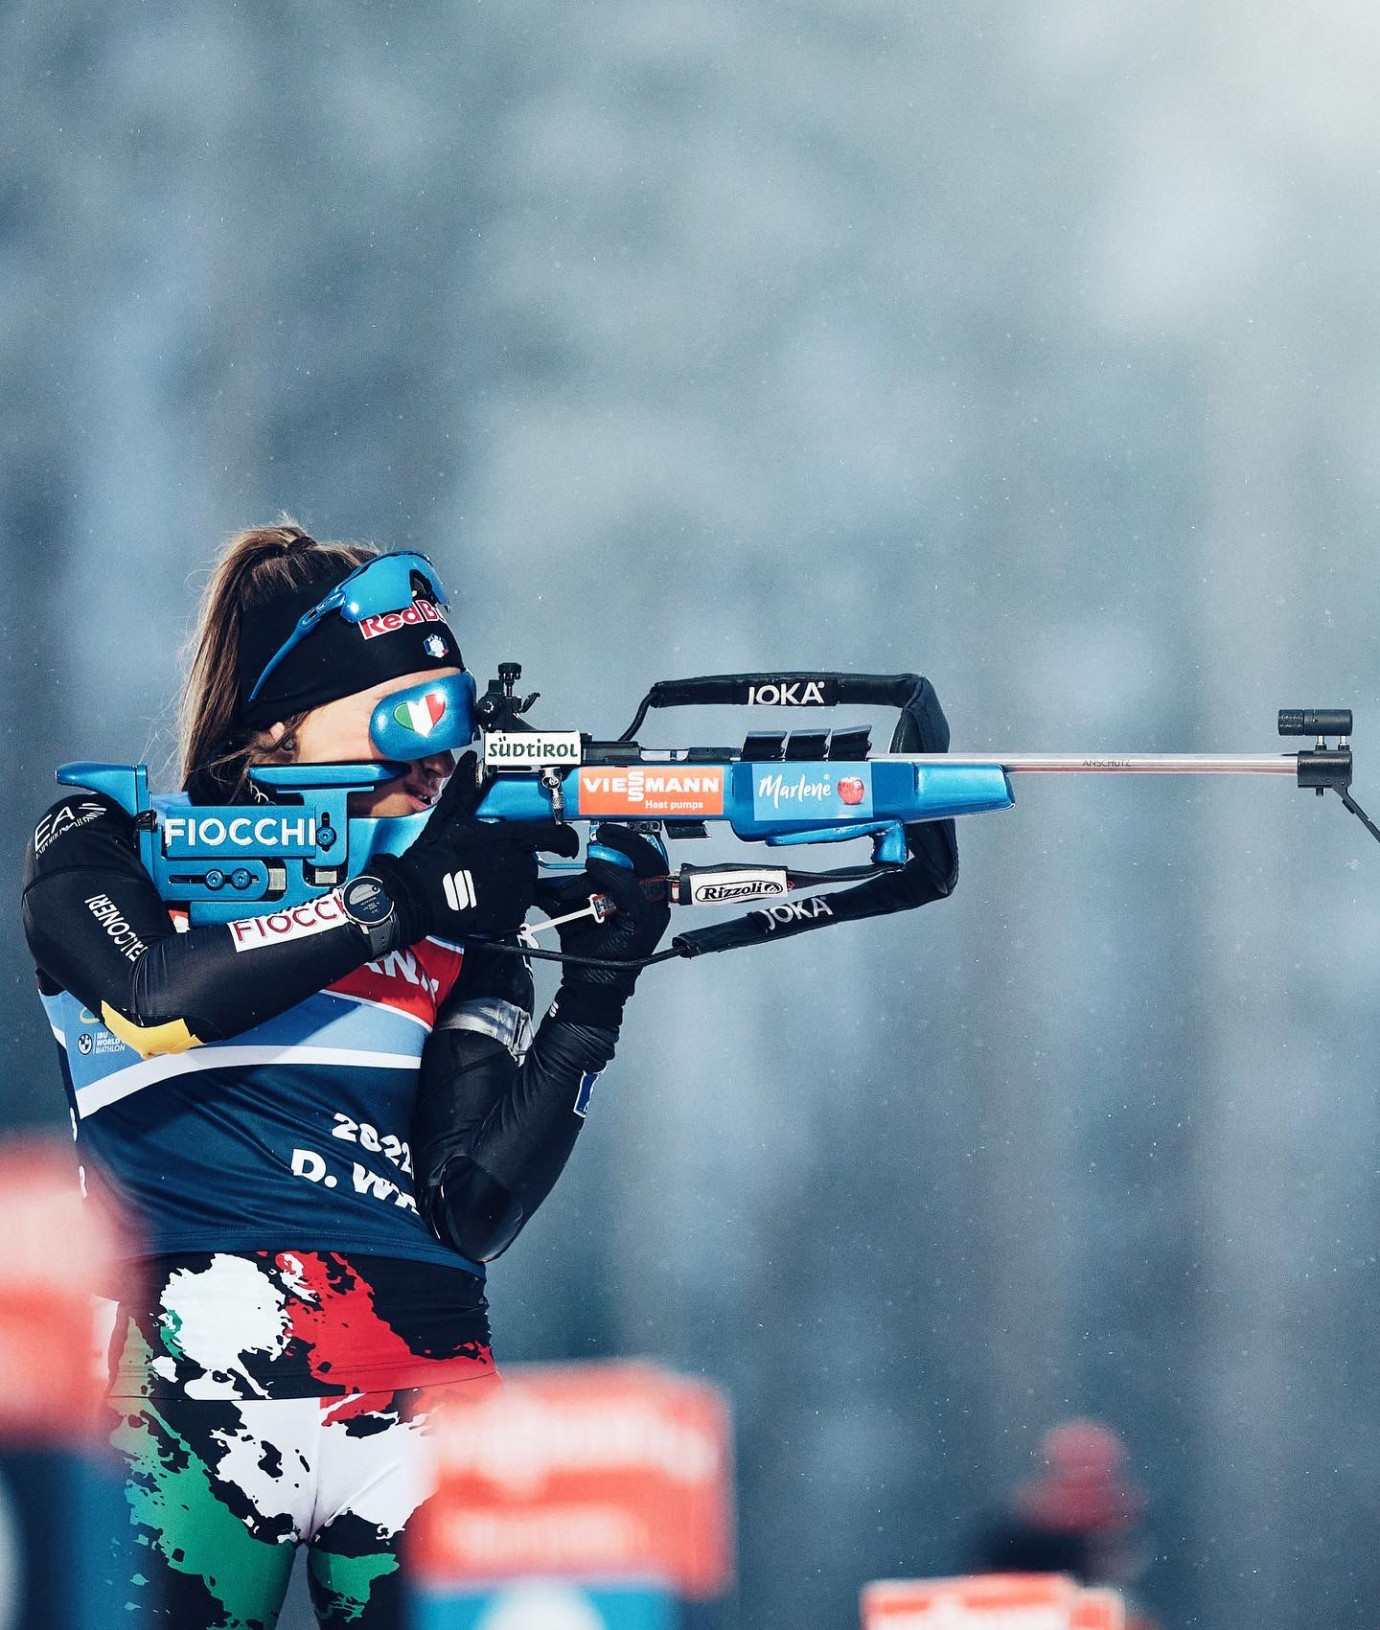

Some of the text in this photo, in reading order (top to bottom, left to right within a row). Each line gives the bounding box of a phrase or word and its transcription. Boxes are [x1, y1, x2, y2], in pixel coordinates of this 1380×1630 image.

[358, 602, 424, 640] Red
[748, 681, 825, 706] JOKA
[582, 771, 719, 802] VIESSMANN
[758, 774, 831, 809] Marlene
[645, 800, 704, 811] Heat pumps
[164, 818, 316, 847] FIOCCHI
[702, 882, 762, 901] Rizzoli
[84, 894, 149, 962] FALCONERI
[758, 897, 834, 931] JOKA
[291, 1148, 338, 1188] D.
